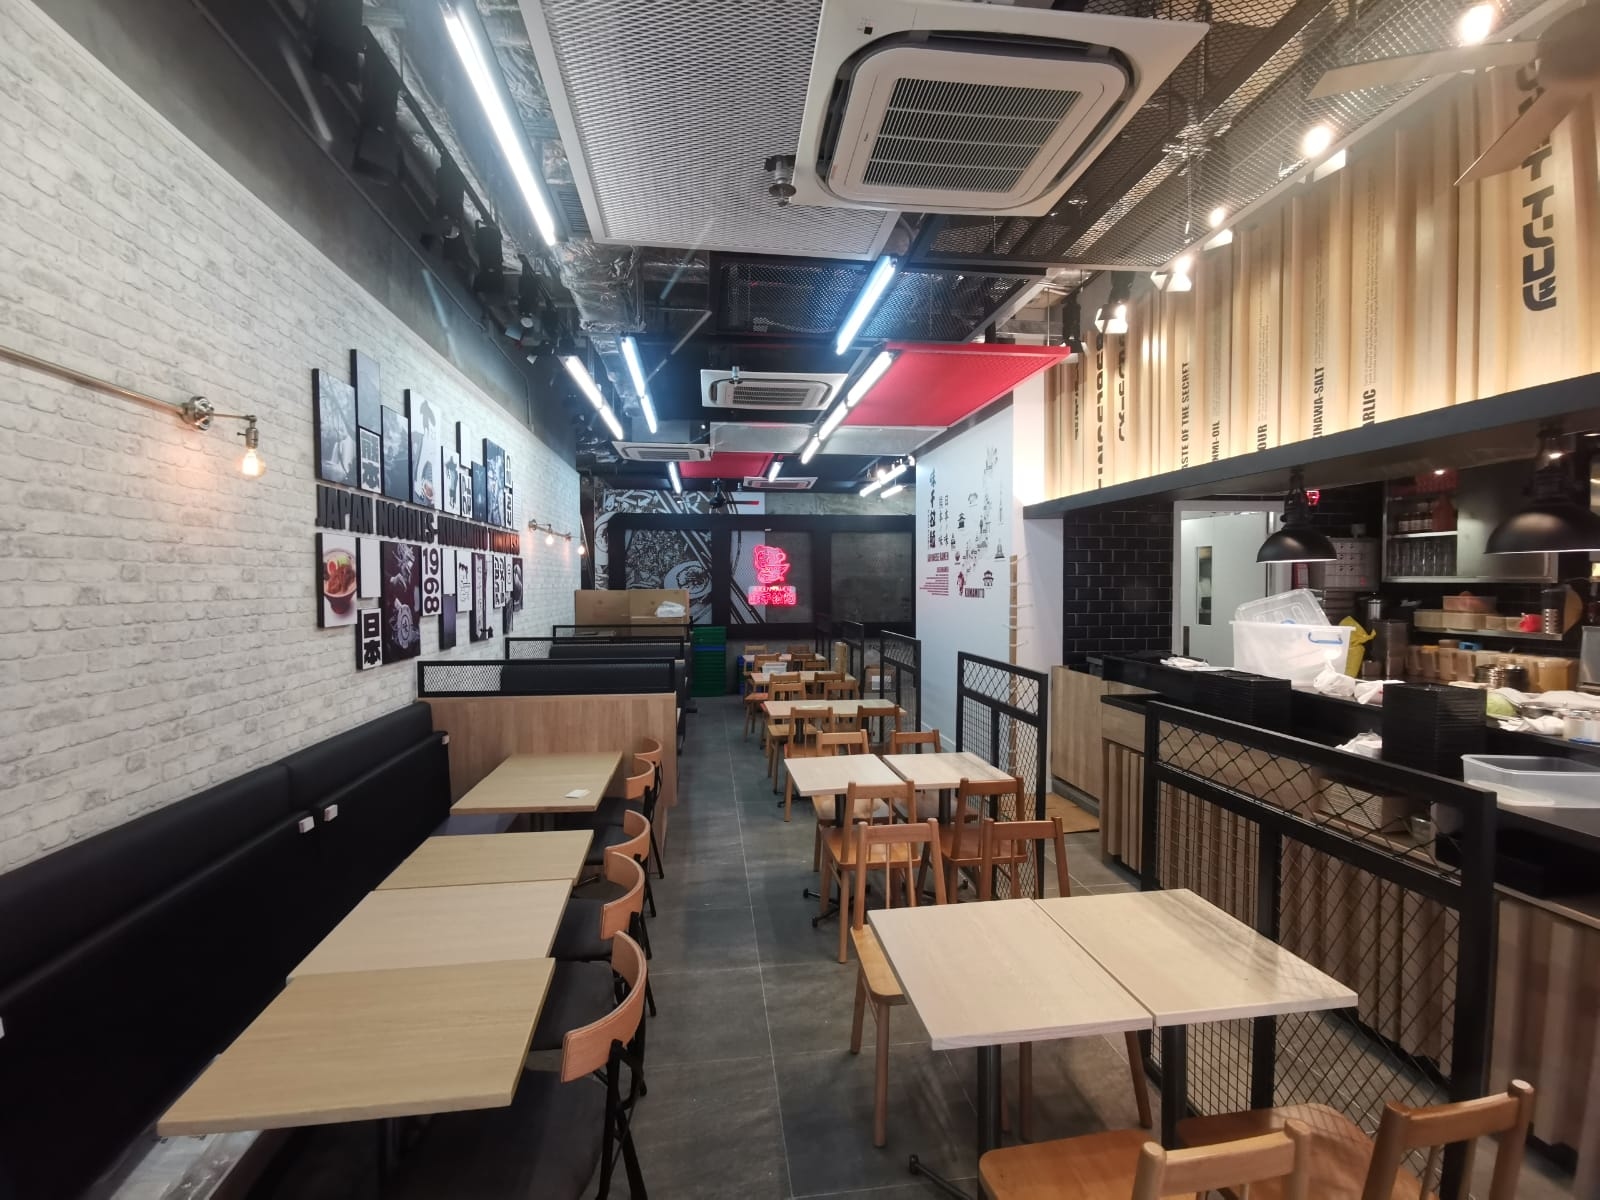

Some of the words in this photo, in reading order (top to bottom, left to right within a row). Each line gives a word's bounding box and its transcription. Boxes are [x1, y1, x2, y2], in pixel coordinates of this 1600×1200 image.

[1181, 361, 1190, 403] SECRET
[1181, 405, 1190, 426] THE
[1362, 388, 1377, 426] RLIC
[1181, 428, 1190, 442] OF
[315, 484, 374, 535] JAPAN
[362, 613, 381, 666] 日本
